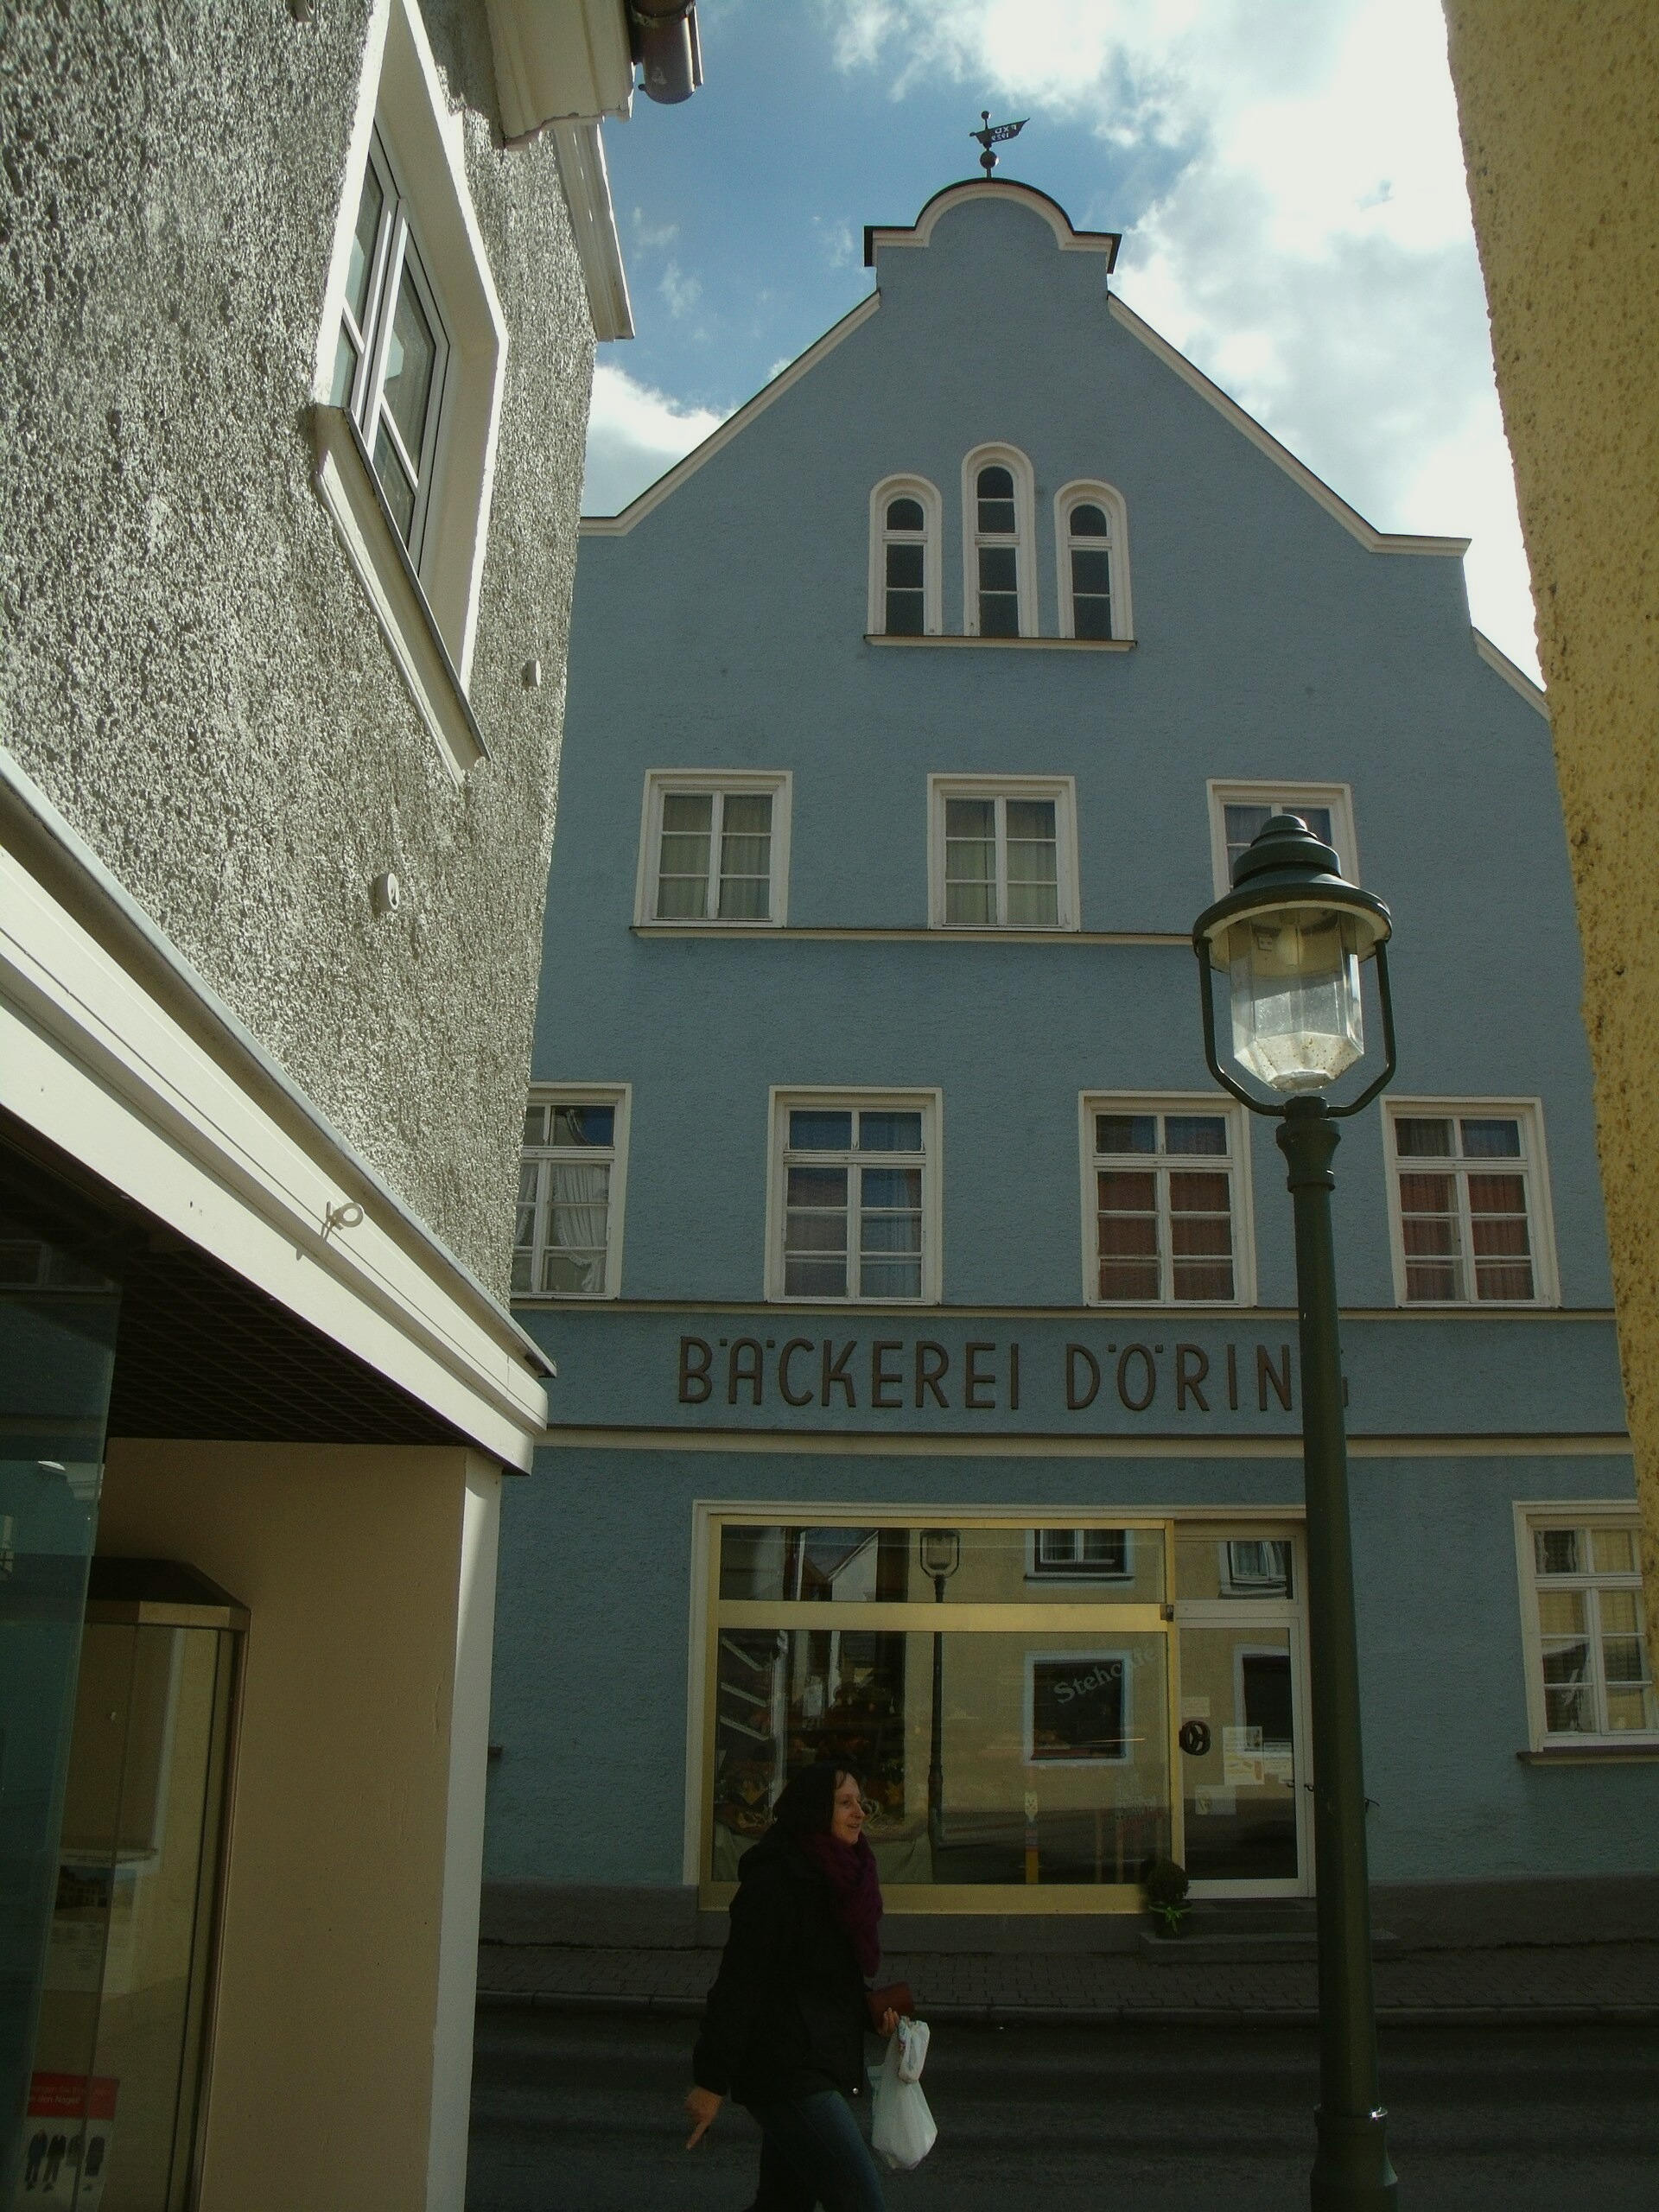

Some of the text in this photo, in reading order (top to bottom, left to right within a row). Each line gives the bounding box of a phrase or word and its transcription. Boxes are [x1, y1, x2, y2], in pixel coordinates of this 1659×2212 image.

[678, 1335, 1349, 1411] BÄCKEREI DÖRIN
[1052, 1644, 1158, 1704] Stehcfé
